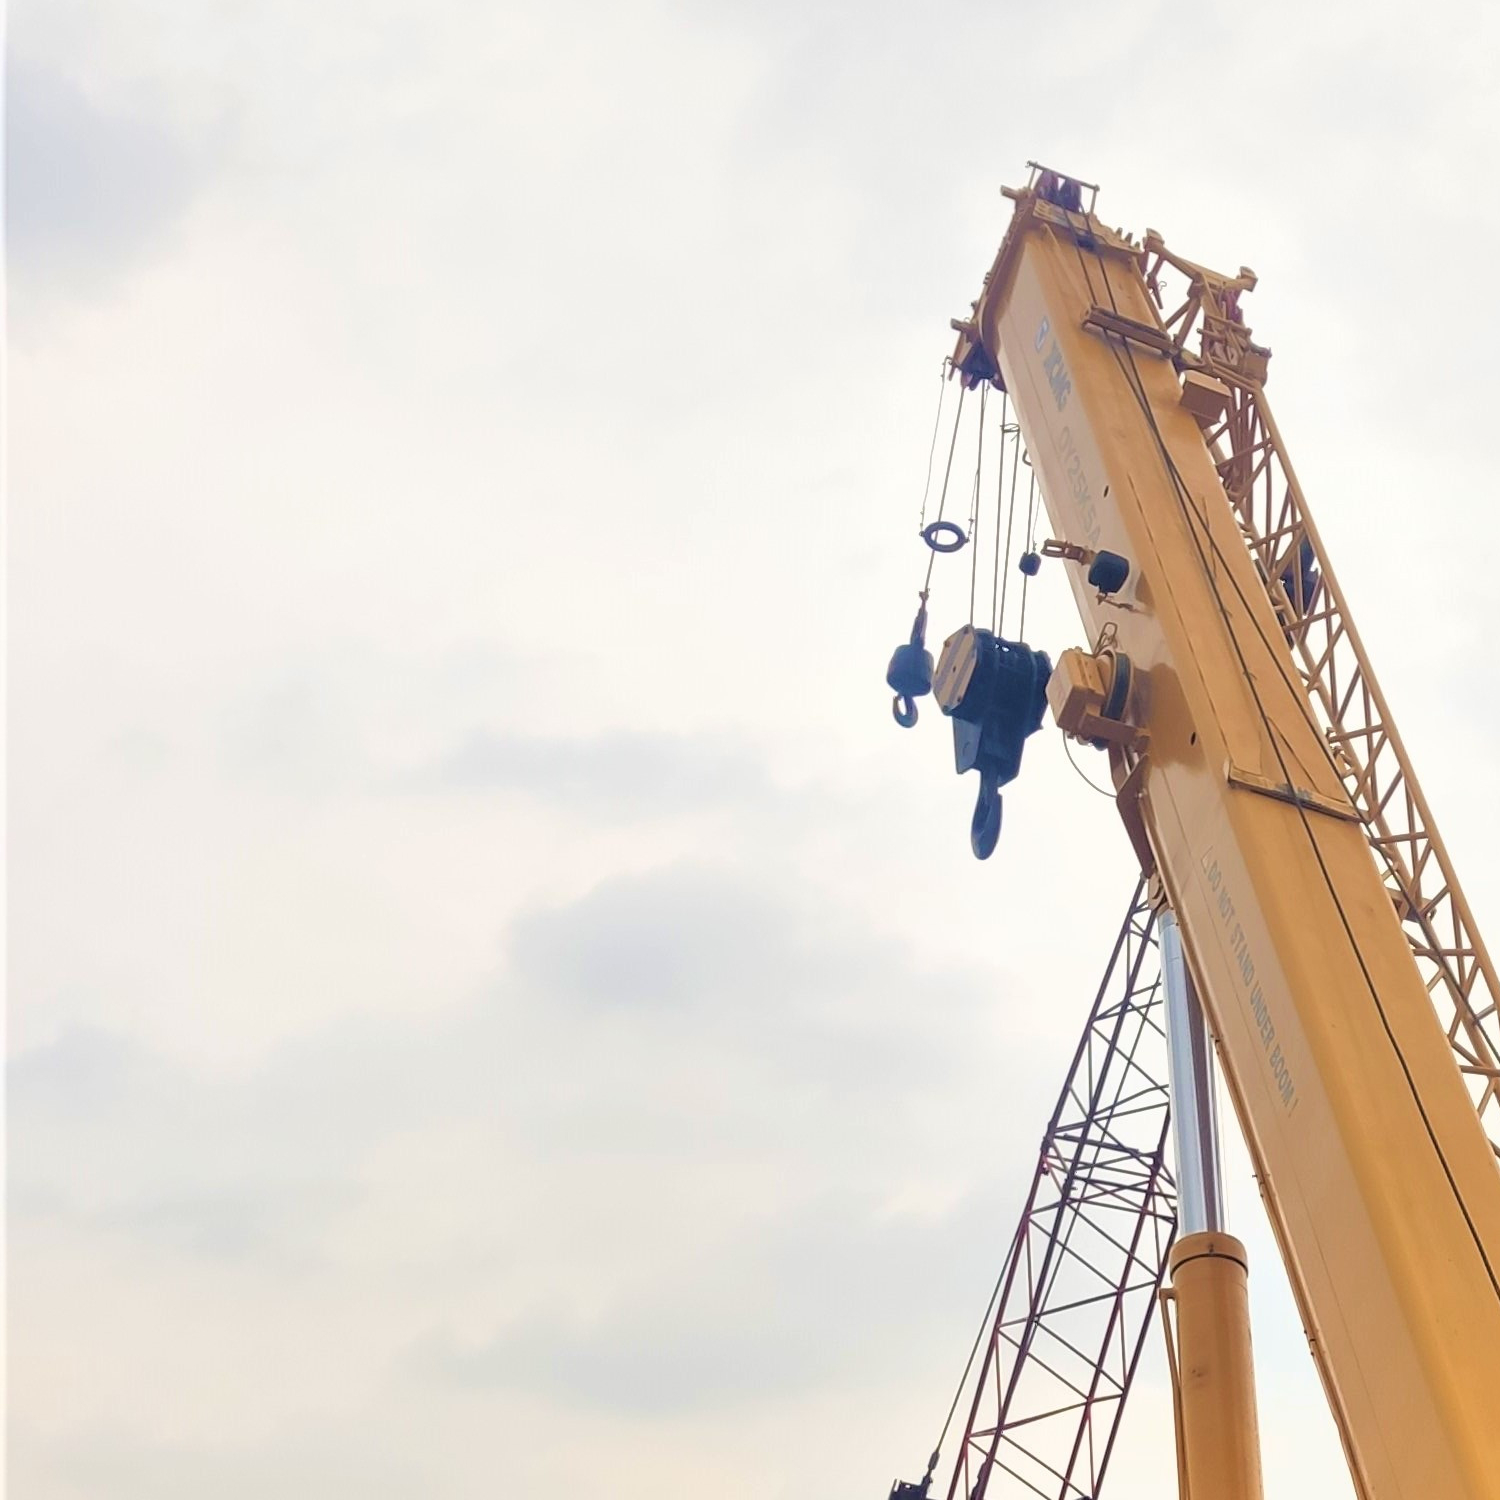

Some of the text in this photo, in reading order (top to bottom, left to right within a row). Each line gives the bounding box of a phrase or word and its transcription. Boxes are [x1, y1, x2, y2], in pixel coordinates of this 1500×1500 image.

[1208, 860, 1222, 892] DO
[1219, 886, 1236, 928] NOT
[1231, 922, 1255, 987] STAND
[1250, 979, 1275, 1052] UNDER
